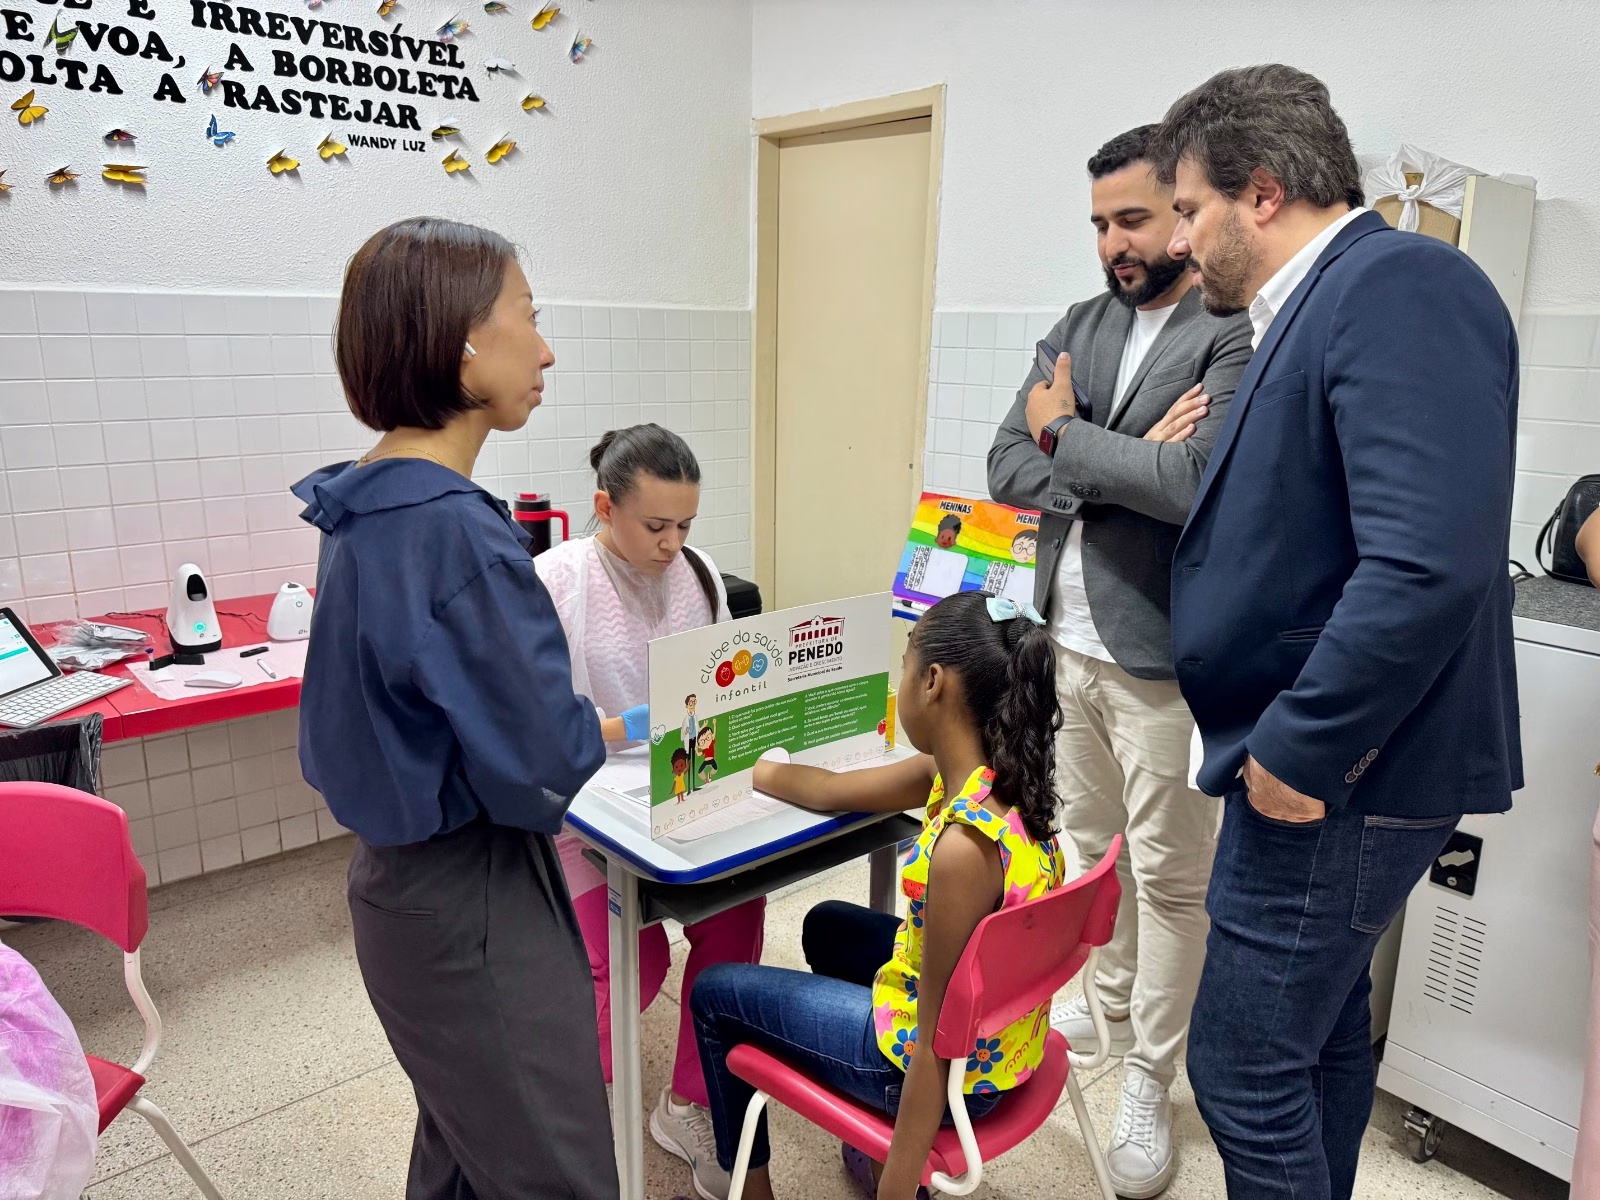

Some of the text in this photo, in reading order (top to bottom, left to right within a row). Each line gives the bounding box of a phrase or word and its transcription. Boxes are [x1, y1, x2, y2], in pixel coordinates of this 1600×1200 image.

[190, 0, 465, 69] IRREVERSÍVEL
[76, 20, 185, 69] VOA,
[224, 43, 254, 71] A
[272, 49, 480, 102] BORBOLETA
[0, 50, 421, 131] OLTA A RASTEJAR
[348, 134, 426, 152] WANDY LUZ
[940, 501, 972, 514] MENINAS
[788, 641, 843, 665] PENEDO
[795, 637, 829, 648] PREFEITURA
[700, 630, 783, 684] clube da saúde
[715, 681, 767, 703] infantil
